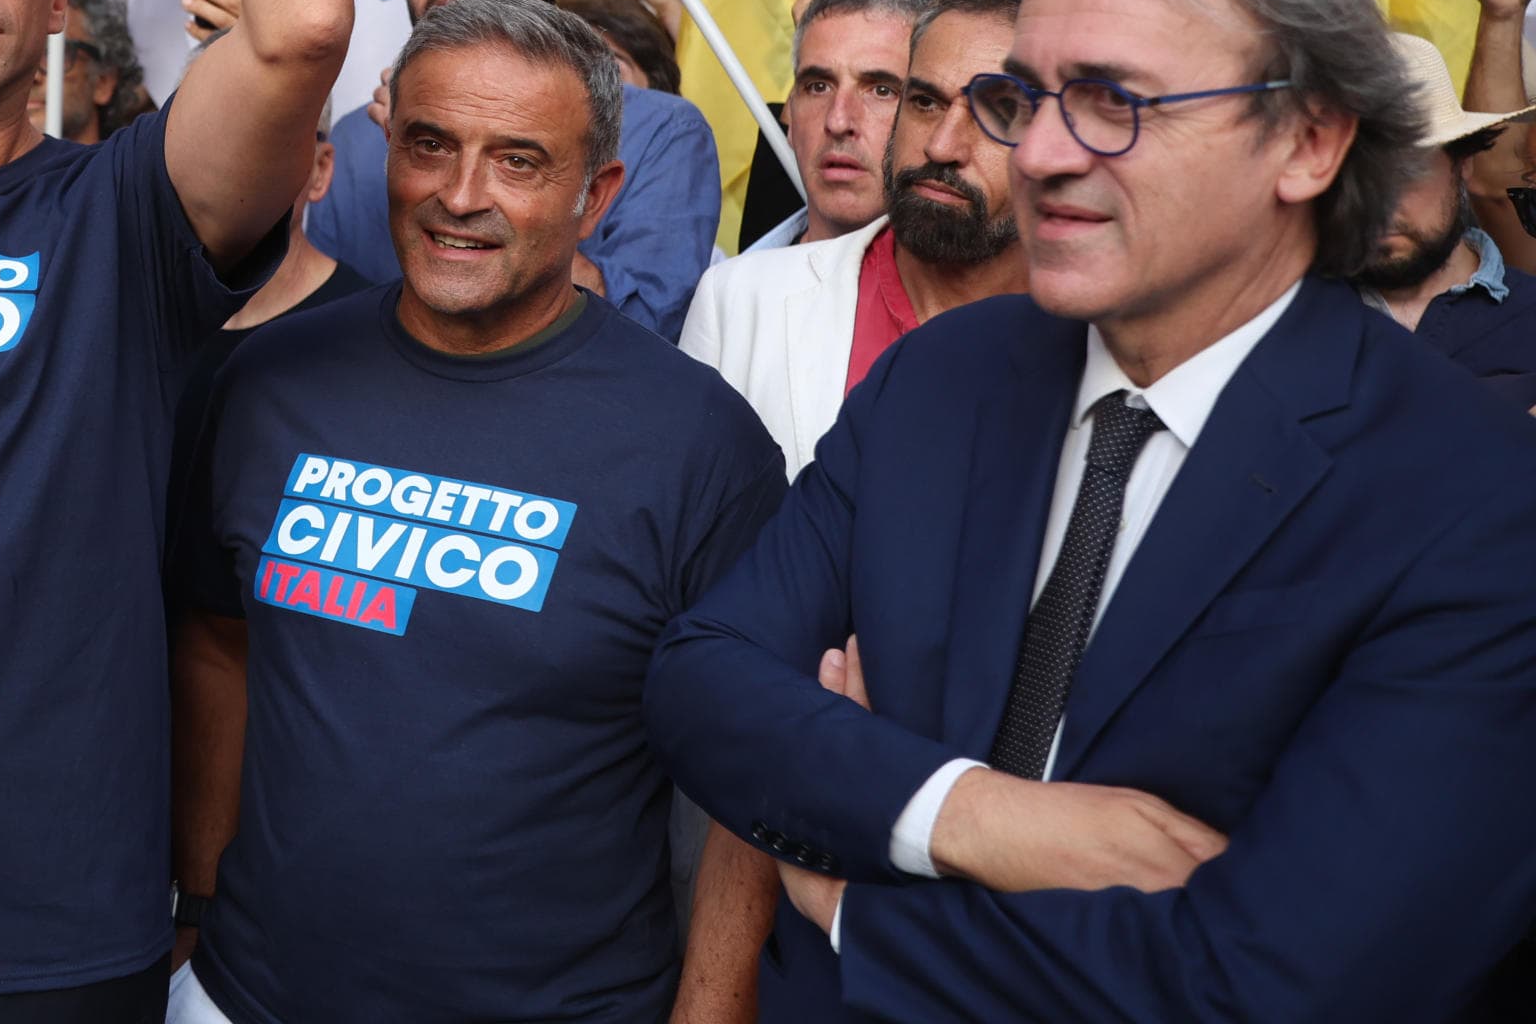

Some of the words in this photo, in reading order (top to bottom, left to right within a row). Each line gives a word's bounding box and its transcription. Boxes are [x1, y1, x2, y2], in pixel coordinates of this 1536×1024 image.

[293, 456, 559, 540] PROGETTO
[277, 504, 539, 600] CIVICO
[259, 560, 397, 630] ITALIA
